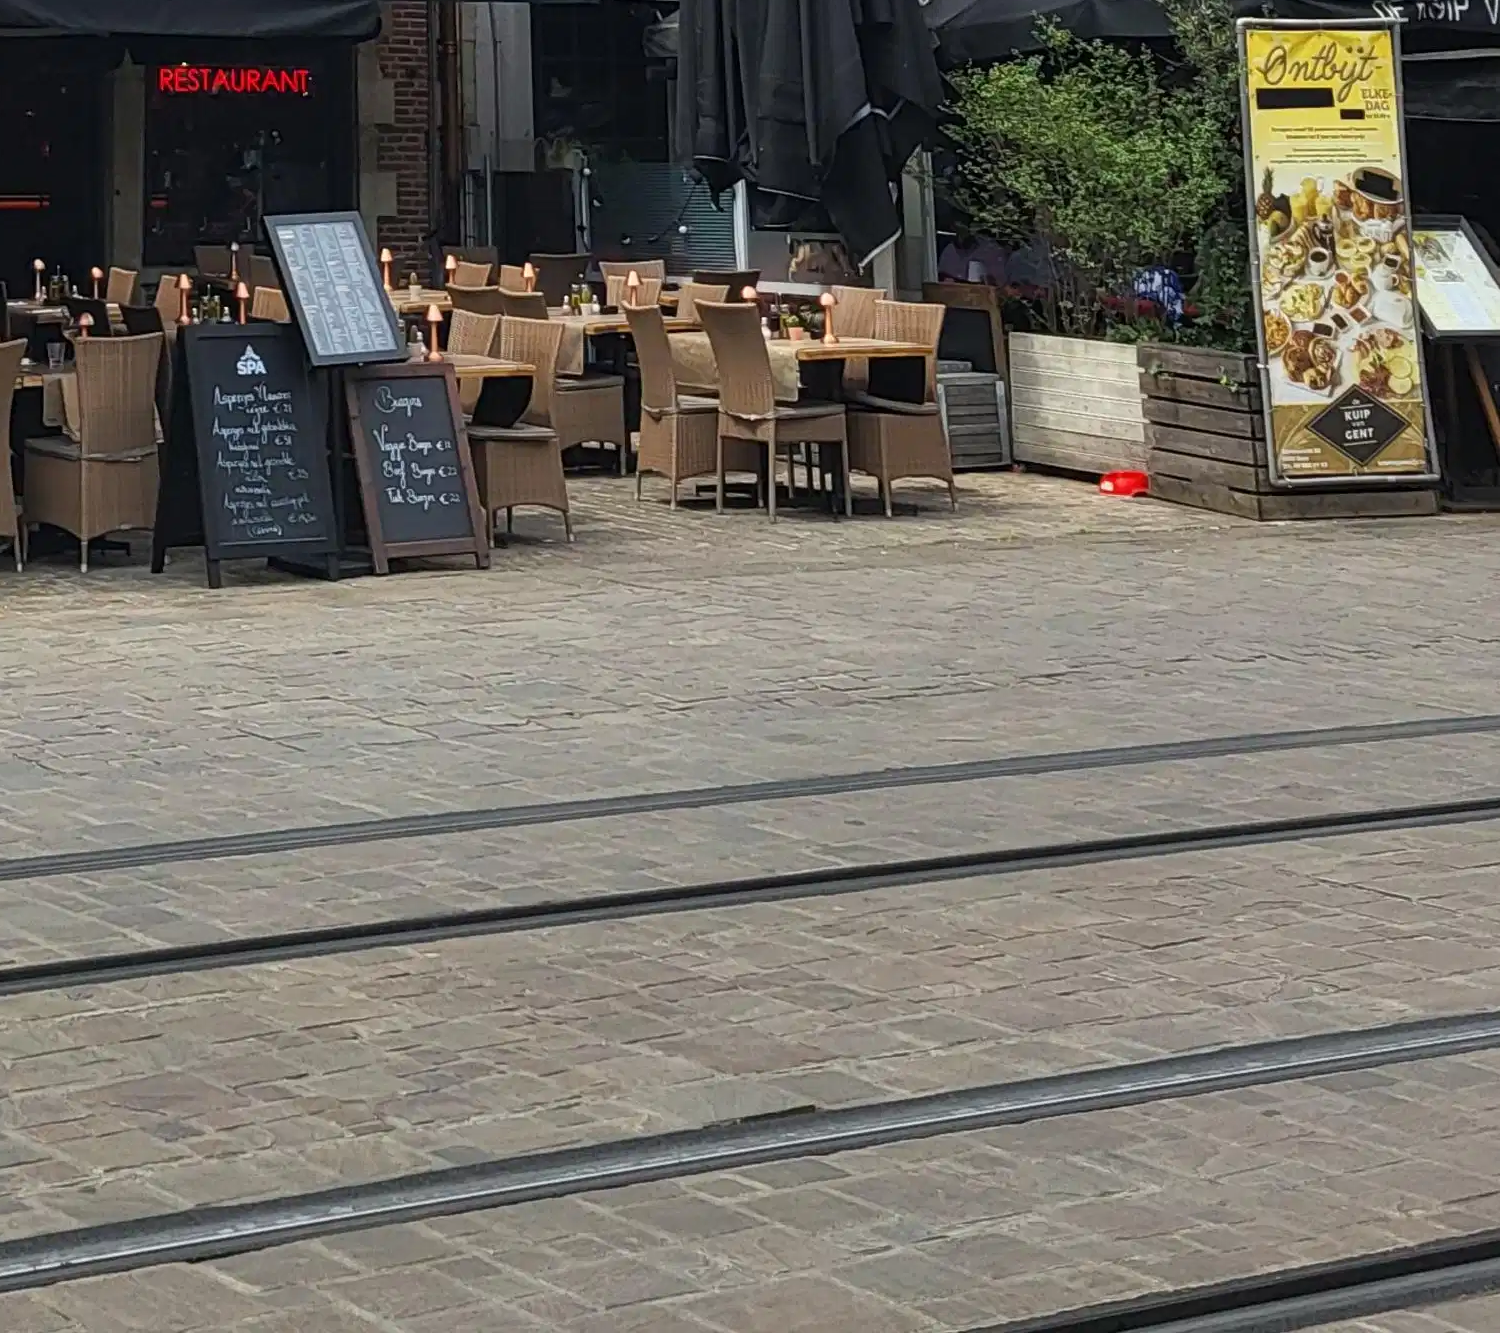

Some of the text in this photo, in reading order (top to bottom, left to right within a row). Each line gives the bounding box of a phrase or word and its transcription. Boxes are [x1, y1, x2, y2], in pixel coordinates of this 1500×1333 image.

[158, 67, 310, 94] RESTAURANT
[1365, 99, 1390, 111] DAG
[236, 360, 267, 375] SPA
[1344, 409, 1371, 422] KUIP
